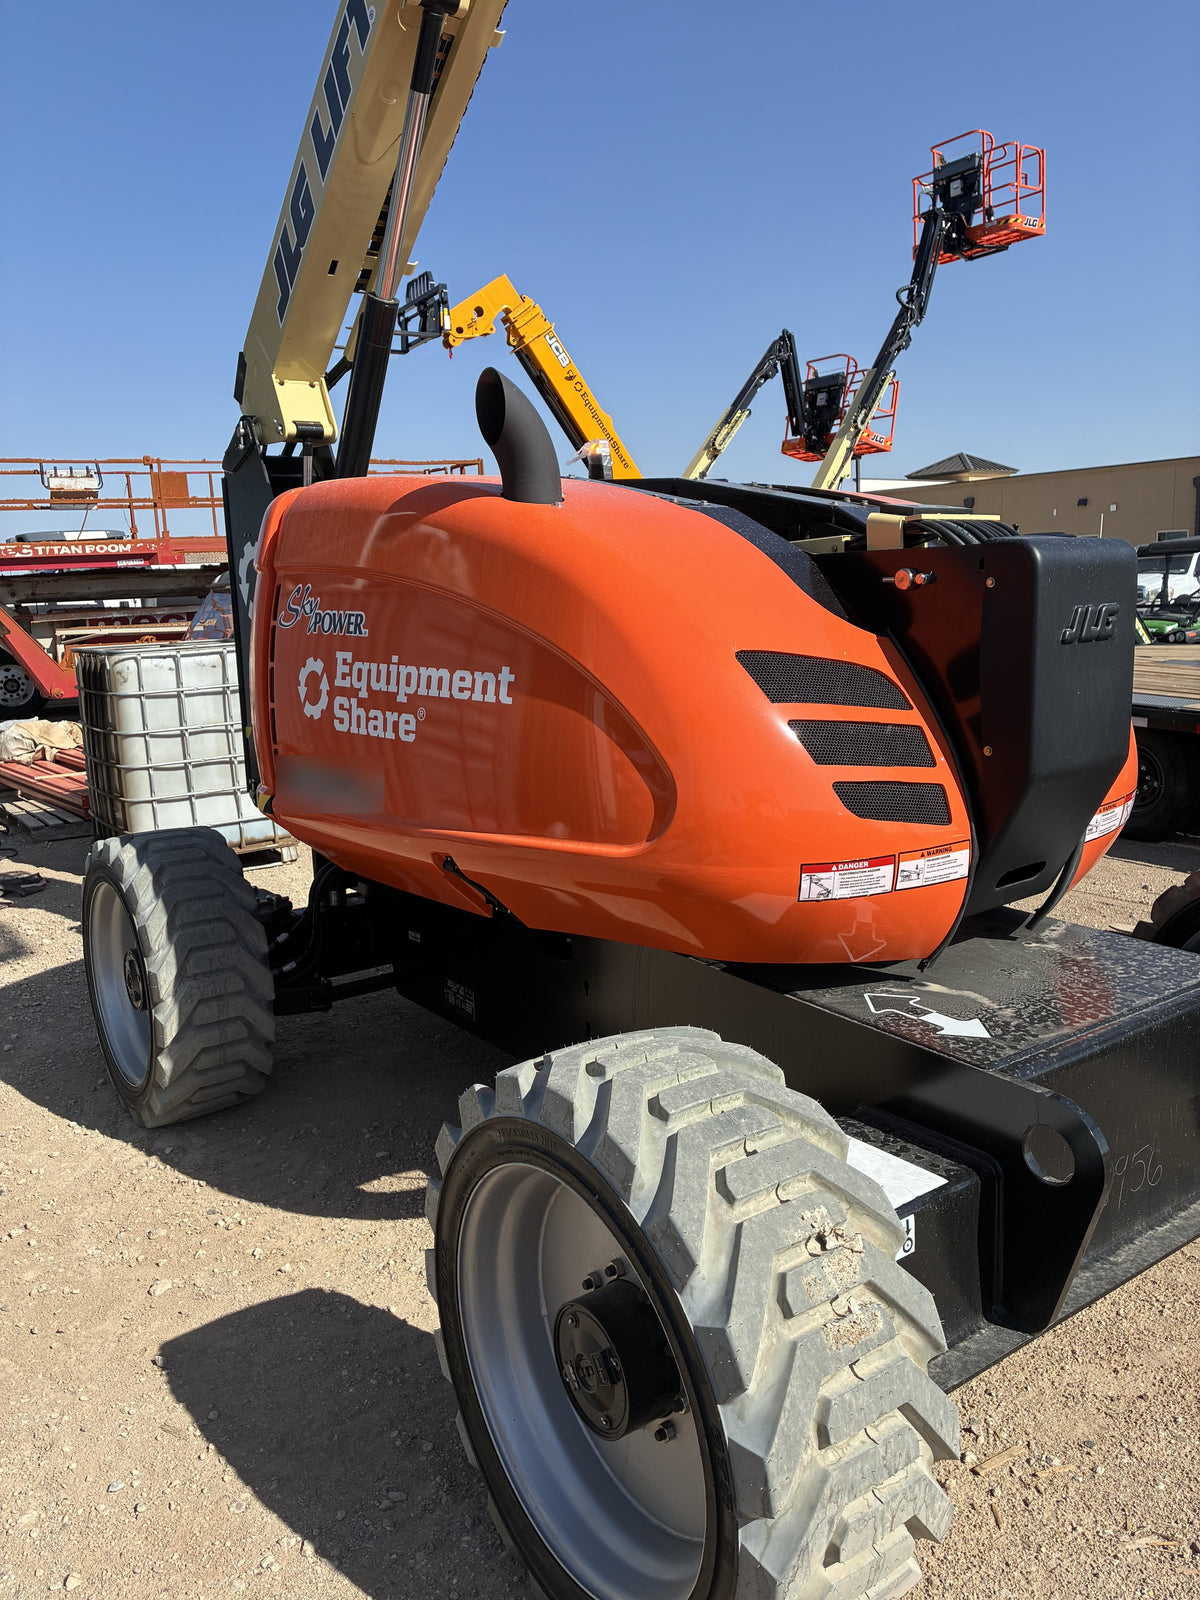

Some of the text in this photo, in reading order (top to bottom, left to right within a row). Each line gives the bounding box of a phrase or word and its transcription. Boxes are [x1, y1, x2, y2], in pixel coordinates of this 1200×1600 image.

[1023, 216, 1039, 228] JLG
[273, 156, 316, 329] JLG
[543, 330, 572, 369] JCB
[870, 433, 885, 444] JLG
[34, 544, 82, 555] TITAN
[311, 610, 365, 636] POWER
[1060, 602, 1120, 645] JLG
[334, 650, 515, 705] Equipment
[926, 845, 953, 857] WARNING
[838, 861, 869, 870] DANGER
[1104, 1143, 1163, 1211] 956
